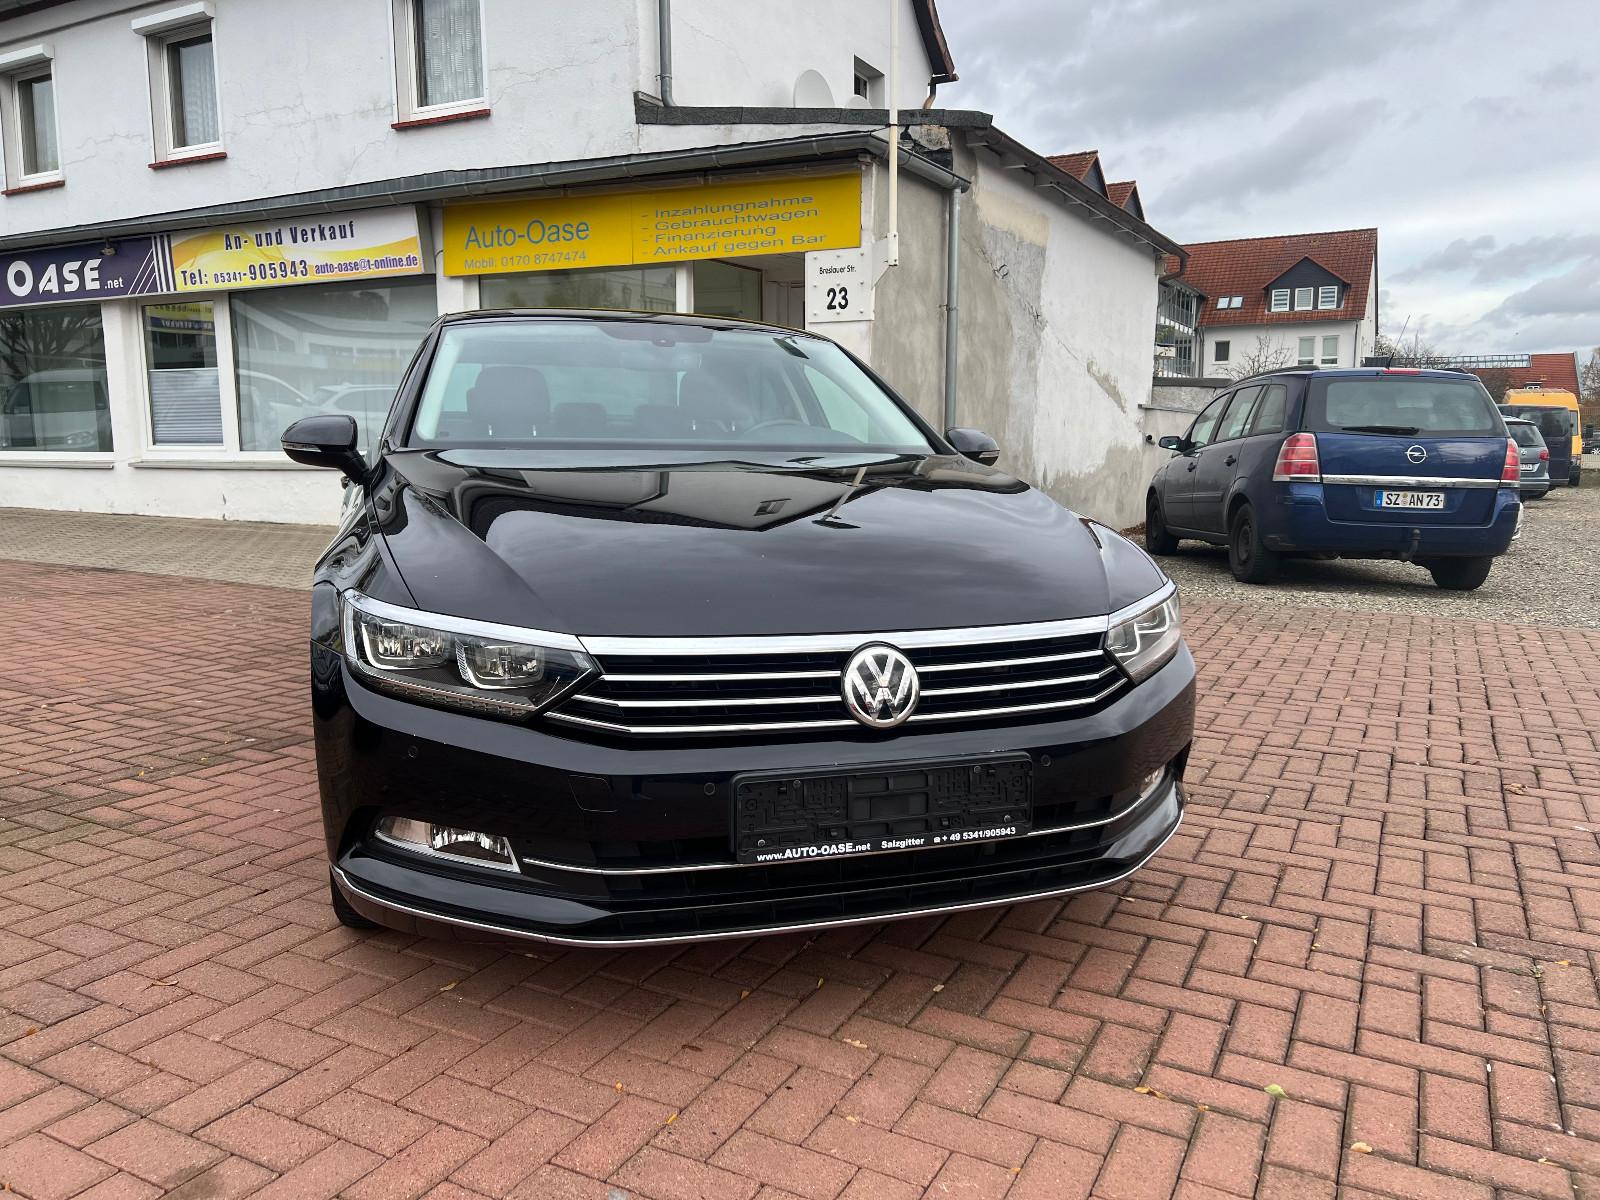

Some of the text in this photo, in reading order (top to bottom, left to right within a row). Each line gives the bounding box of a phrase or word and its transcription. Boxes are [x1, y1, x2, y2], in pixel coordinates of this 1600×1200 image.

[654, 195, 814, 219] Inzahlungnahme
[654, 207, 819, 231] Gebrauchtwagen
[225, 221, 355, 251] An- und Verkauf
[464, 218, 591, 250] Auto-Oase
[653, 242, 718, 257] Ankauf
[723, 238, 785, 253] gegen
[791, 233, 827, 246] Bar
[654, 225, 777, 244] Finanzierung
[181, 254, 419, 286] Tel: 05341-905943 auto-oase@t-online.de
[464, 250, 588, 270] Mobil: 0170 8747474
[819, 264, 857, 275] Breslauer Str.
[826, 287, 849, 310] 23
[1385, 493, 1400, 506] SZ
[1409, 494, 1424, 507] AN
[1426, 494, 1441, 507] 73
[757, 842, 871, 862] www.AUTO-OASE.net
[881, 838, 925, 849] Salzgitter
[949, 832, 961, 841] 49
[963, 826, 1016, 840] 5341/905943
